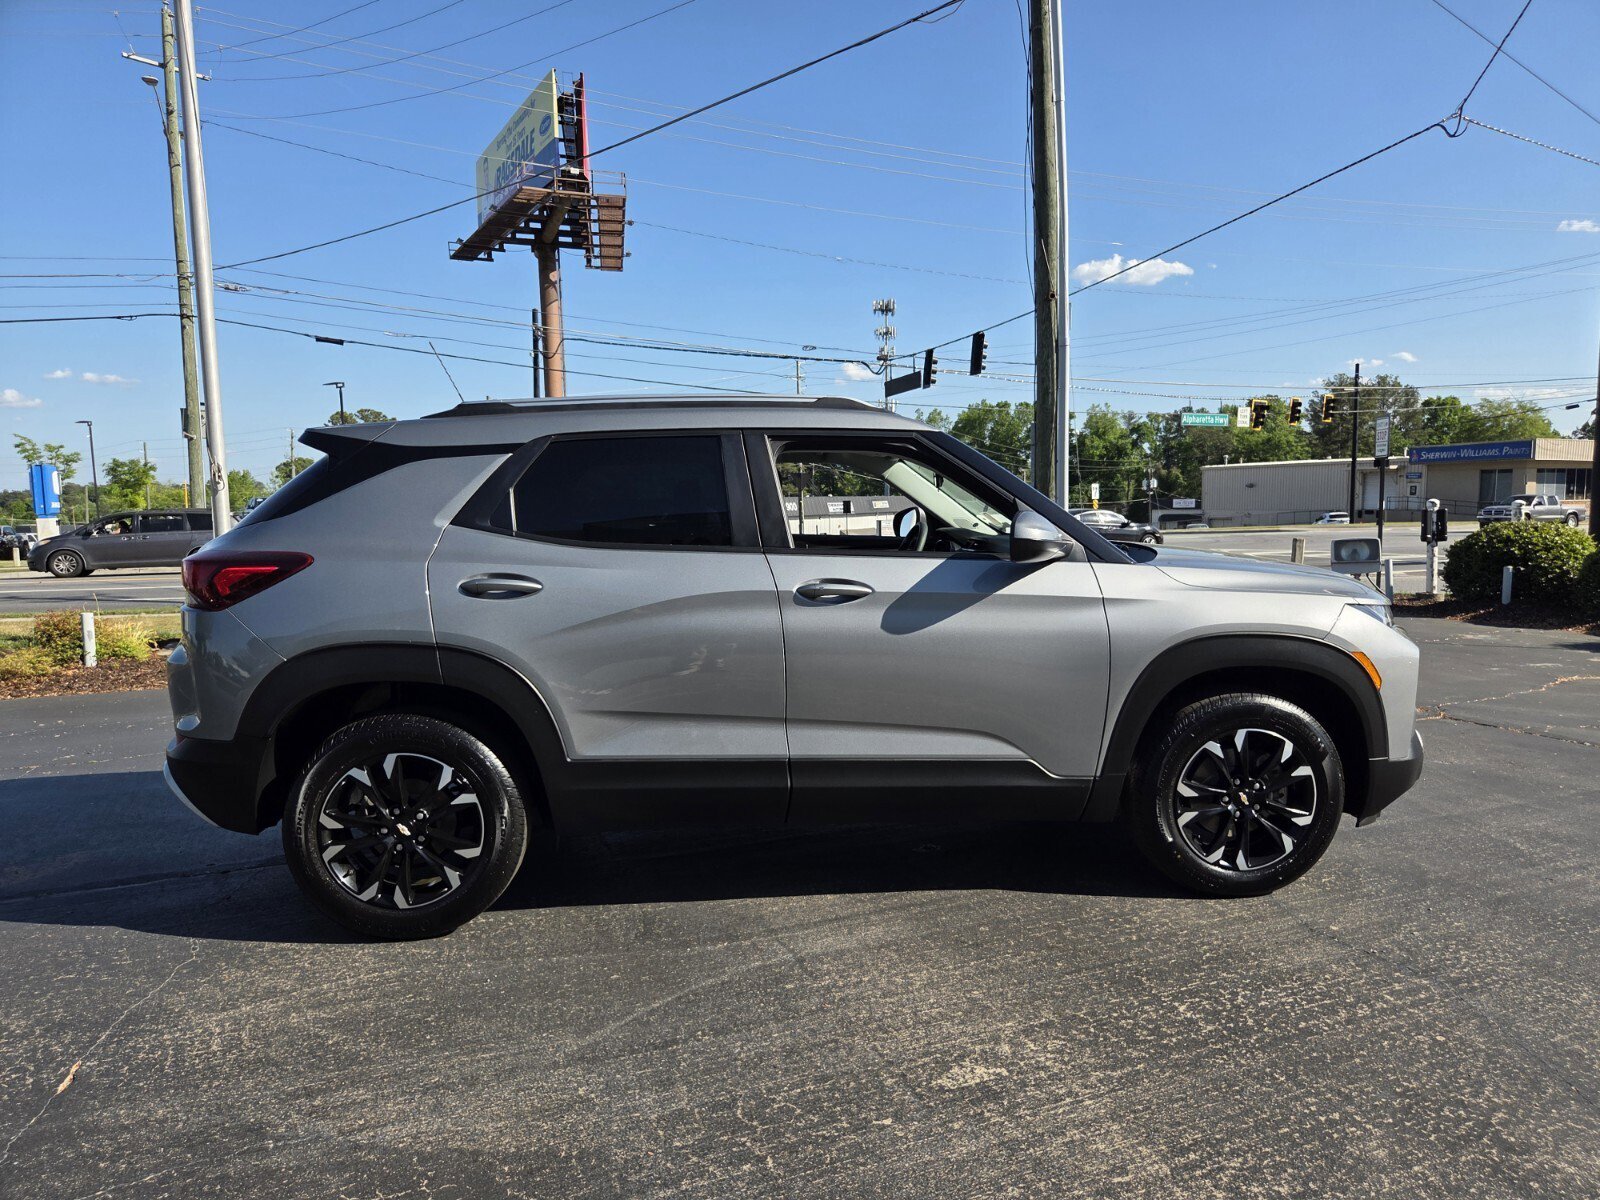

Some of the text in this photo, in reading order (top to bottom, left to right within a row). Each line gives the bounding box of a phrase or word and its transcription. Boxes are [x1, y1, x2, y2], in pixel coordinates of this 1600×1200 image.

[1182, 414, 1228, 426] Alpharetta Hwy
[1502, 446, 1530, 456] PAINTS
[785, 502, 798, 511] 900
